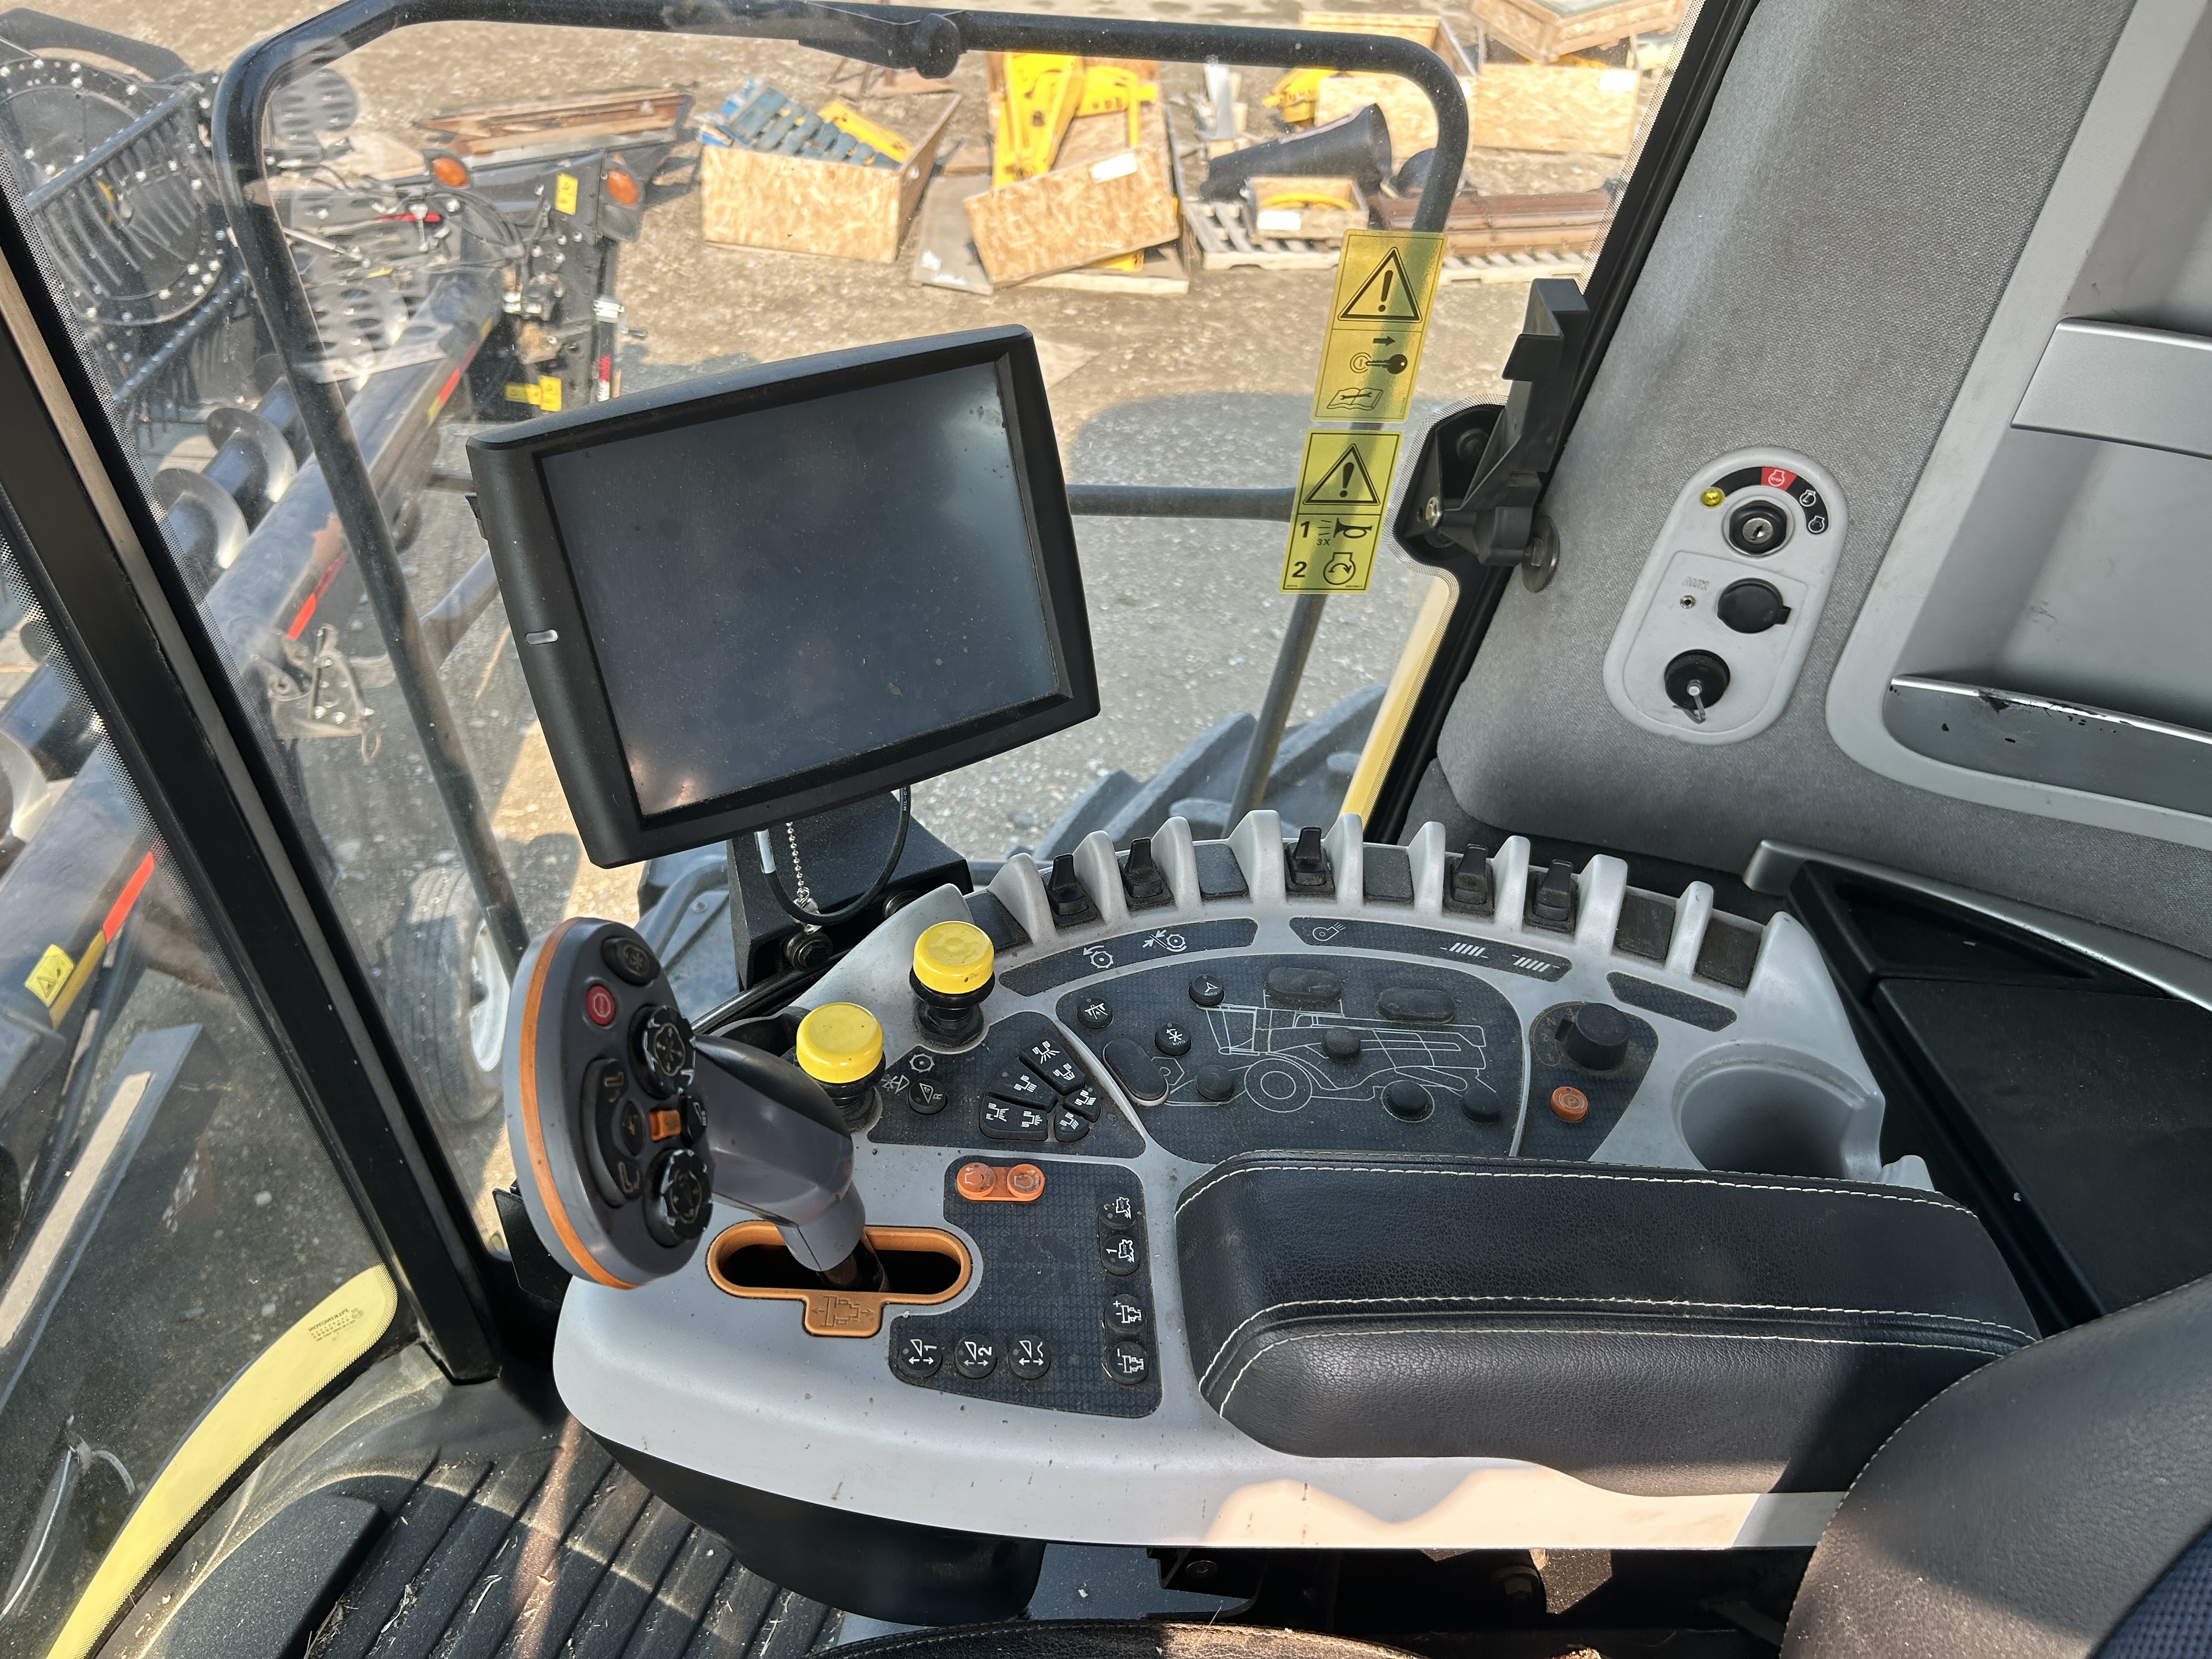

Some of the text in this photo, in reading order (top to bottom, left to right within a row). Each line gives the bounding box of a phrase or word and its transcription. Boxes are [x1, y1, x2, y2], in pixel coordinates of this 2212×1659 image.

[1300, 521, 1310, 538] 1
[1317, 538, 1331, 546] 3X
[1291, 561, 1307, 578] 2
[1681, 576, 1709, 591] AUX
[1567, 1007, 1574, 1017] 3
[1546, 1017, 1557, 1026] N
[978, 1346, 992, 1356] 2
